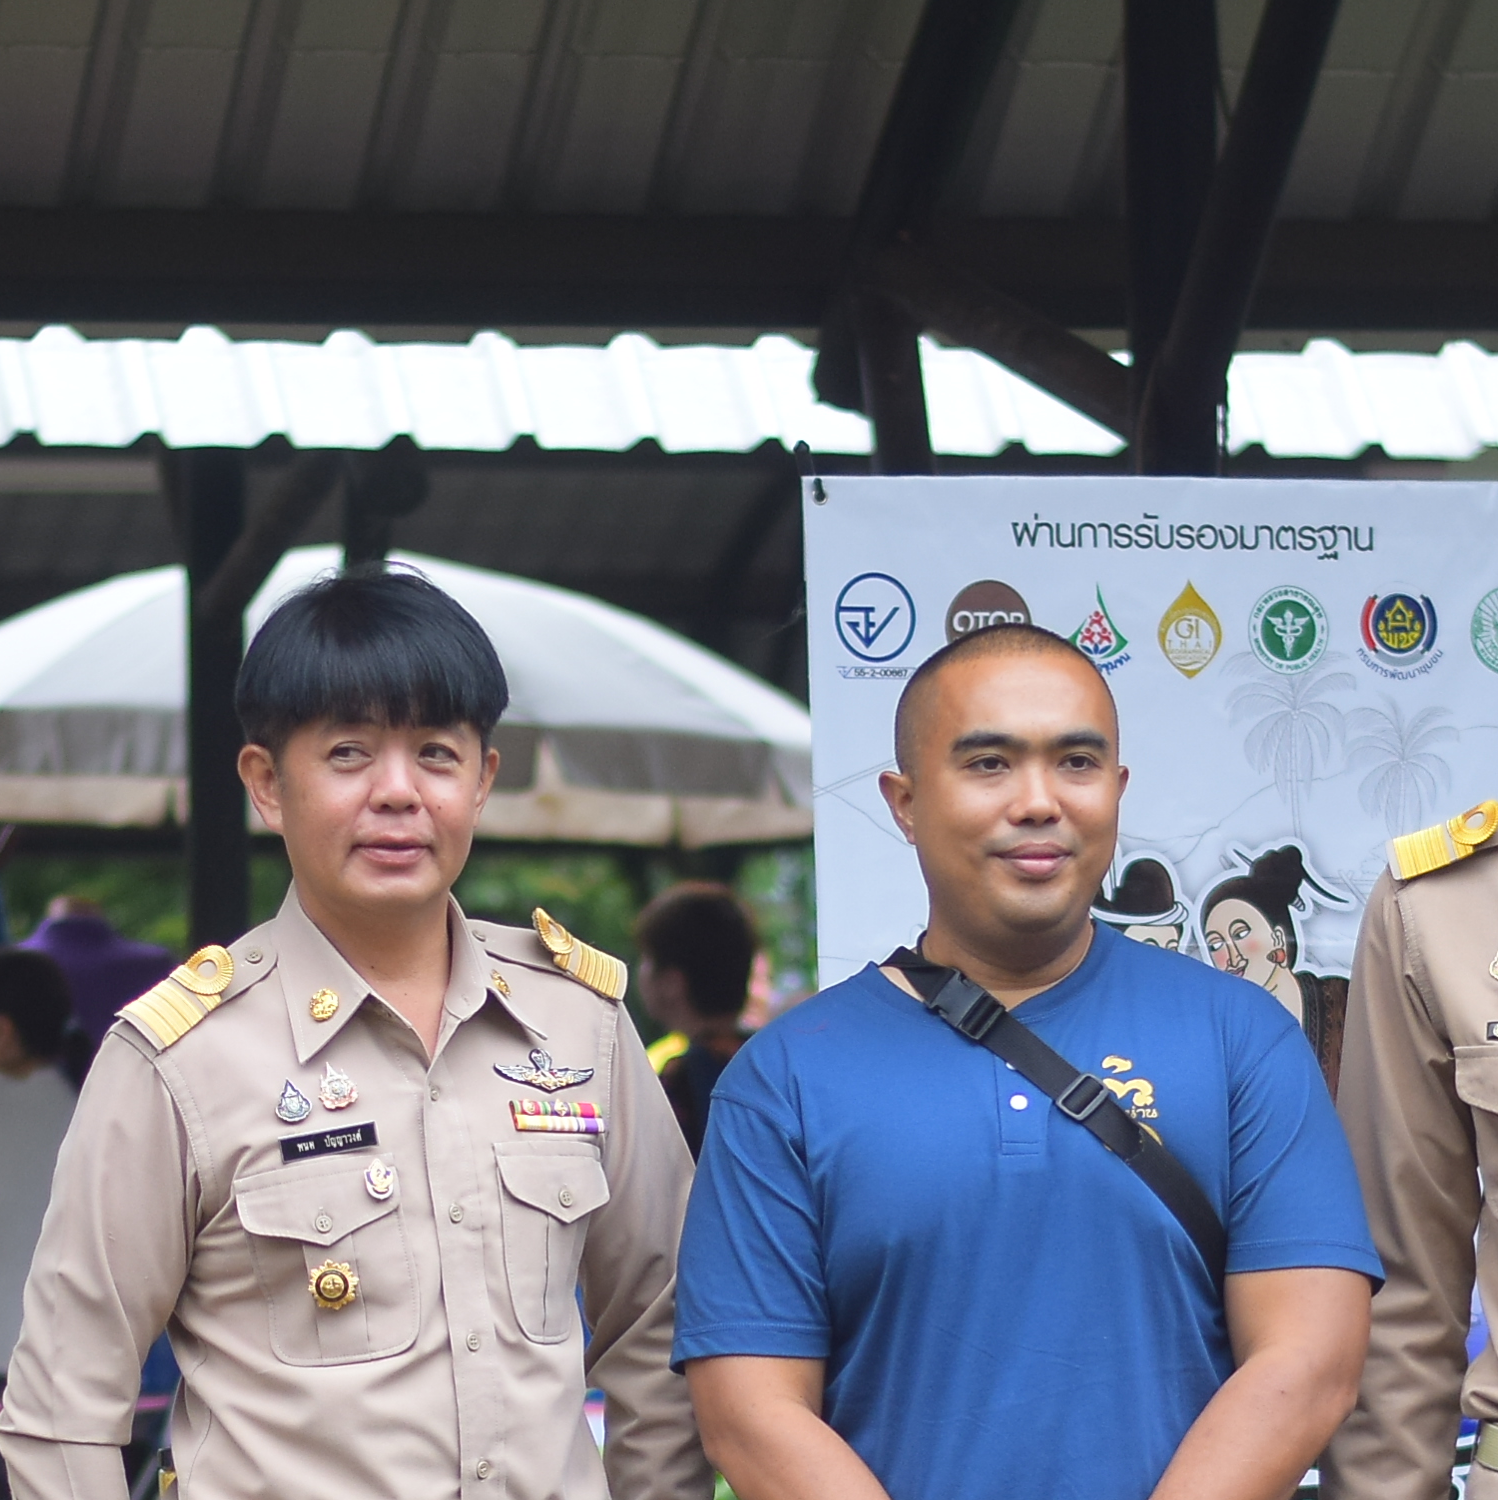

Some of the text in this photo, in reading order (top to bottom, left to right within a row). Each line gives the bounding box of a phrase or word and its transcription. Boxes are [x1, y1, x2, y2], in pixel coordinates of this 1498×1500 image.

[1011, 512, 1374, 560] ผ่านการรับรองมาตรฐาน
